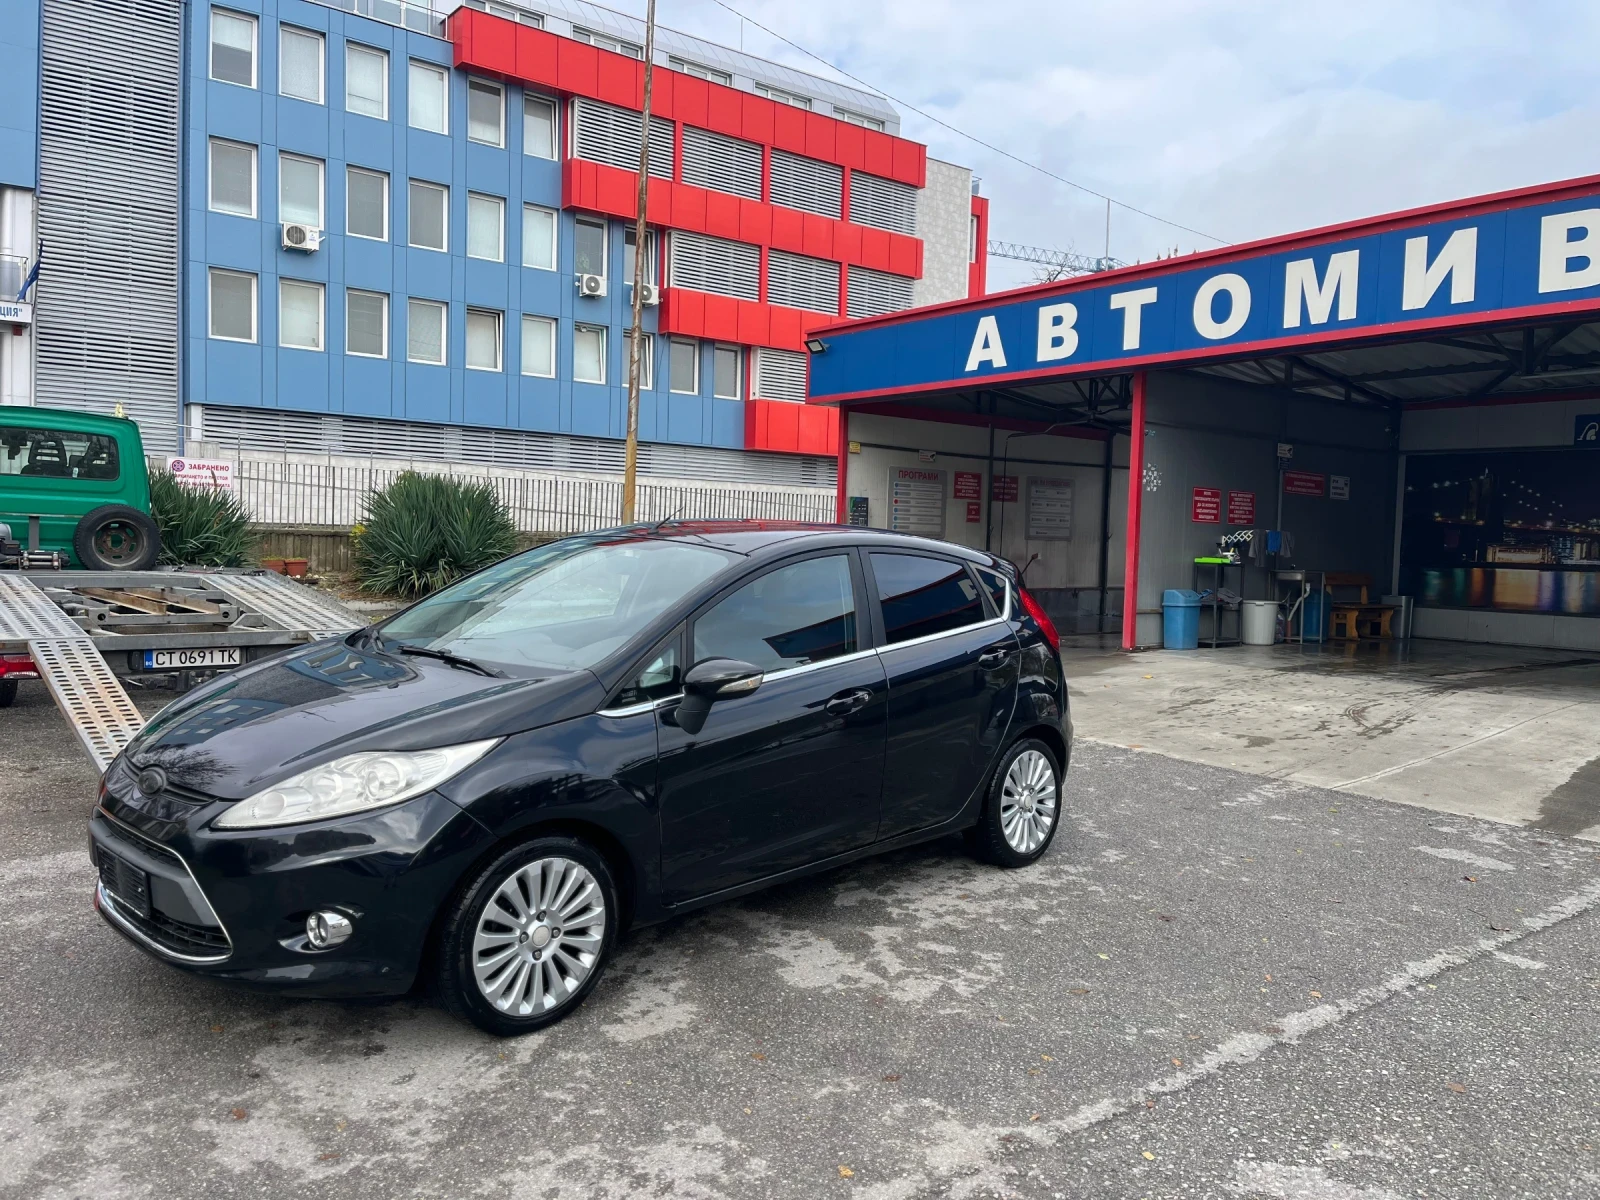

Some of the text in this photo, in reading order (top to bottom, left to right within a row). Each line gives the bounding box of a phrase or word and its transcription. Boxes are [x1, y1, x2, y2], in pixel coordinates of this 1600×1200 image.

[188, 463, 230, 471] ЗАБРАНЕНО
[898, 470, 940, 481] ПРОГРАМИ
[155, 651, 176, 666] CT
[179, 650, 214, 665] 0691
[218, 649, 237, 663] TK
